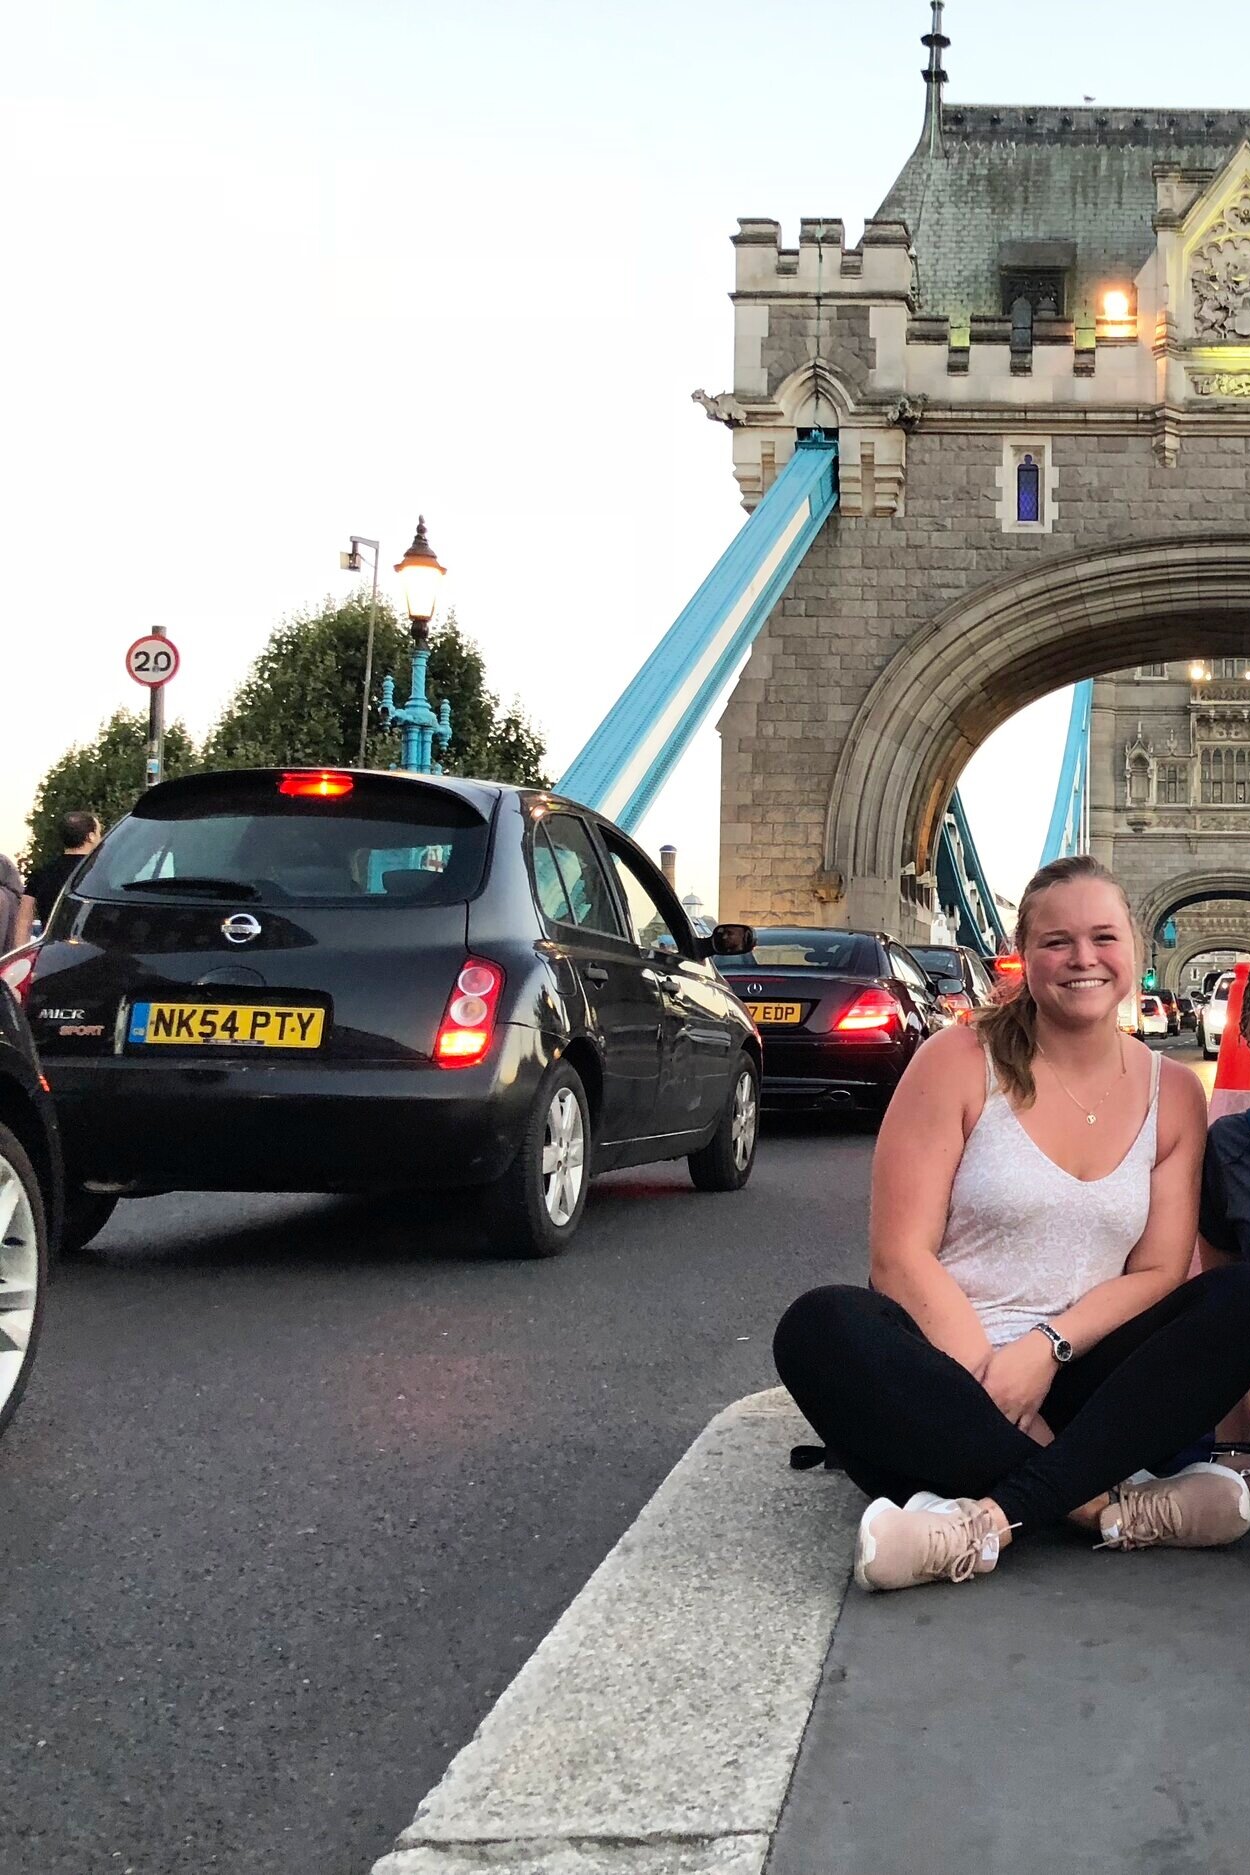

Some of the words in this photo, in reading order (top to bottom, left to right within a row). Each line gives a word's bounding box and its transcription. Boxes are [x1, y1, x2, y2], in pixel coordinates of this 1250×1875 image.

[135, 651, 171, 672] 20
[762, 1006, 795, 1020] EDP
[59, 1025, 106, 1036] SPORT
[153, 1007, 239, 1040] NK54
[249, 1010, 315, 1041] PTY
